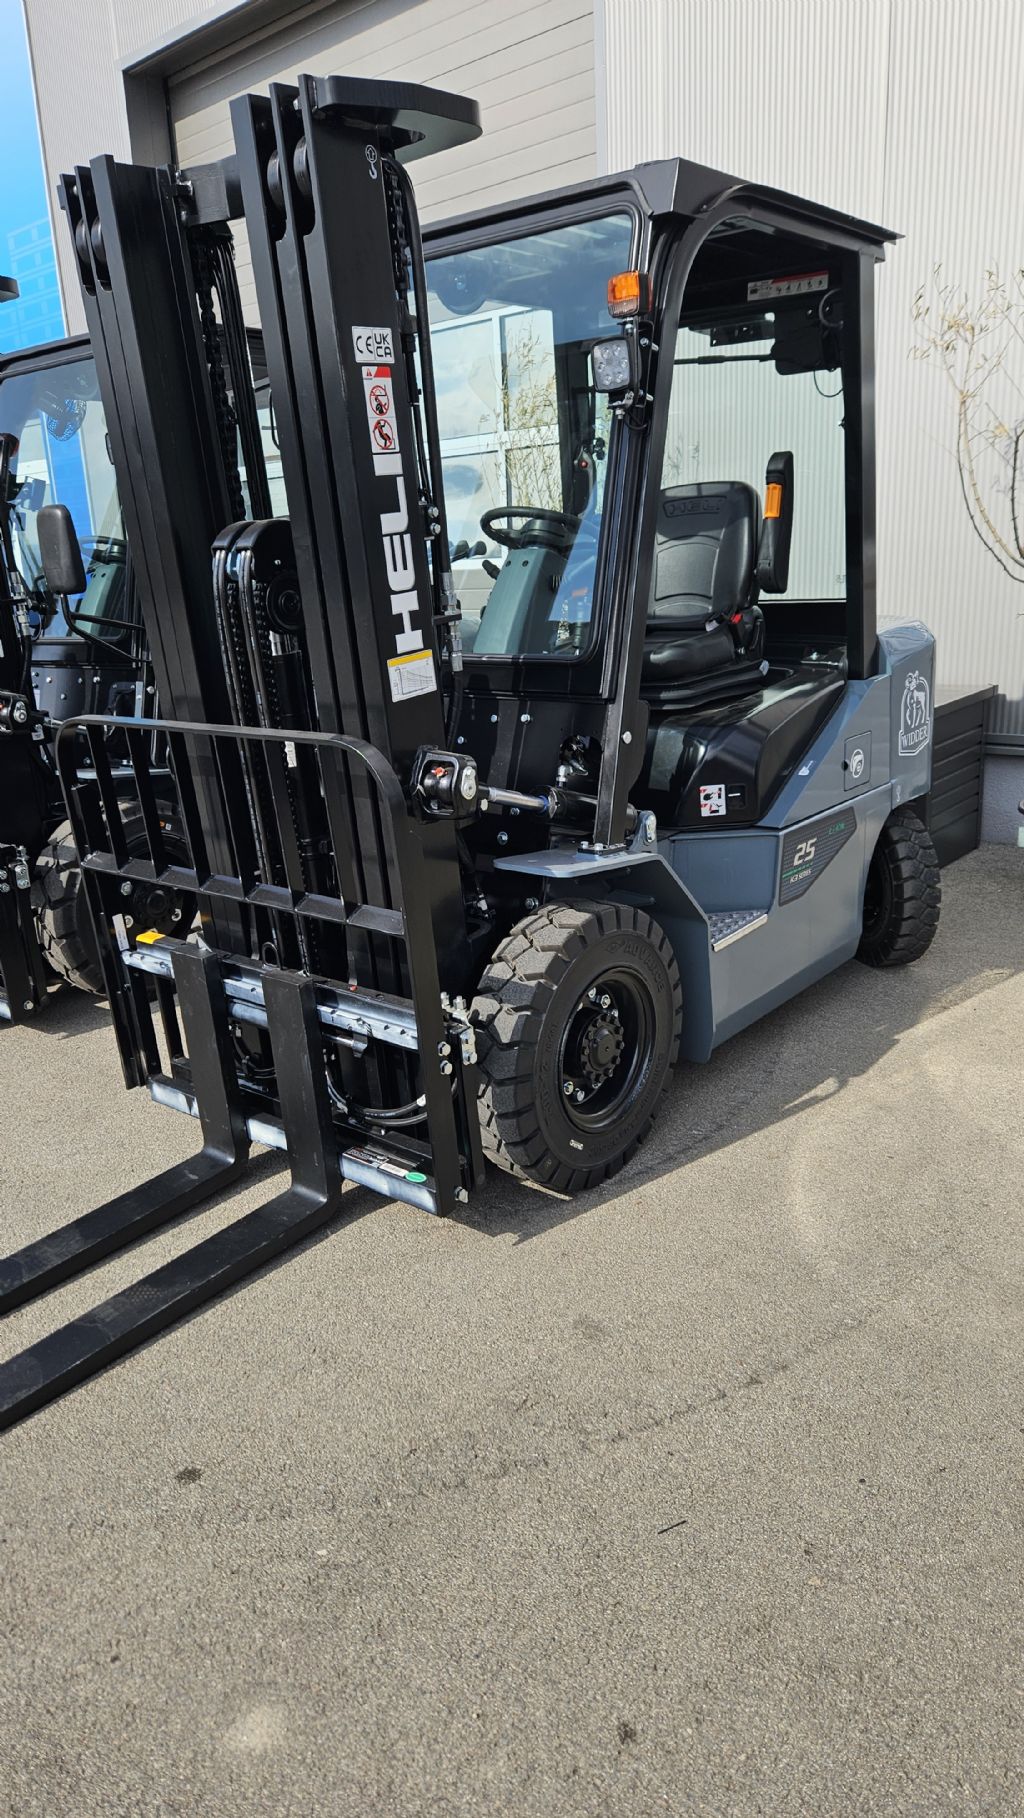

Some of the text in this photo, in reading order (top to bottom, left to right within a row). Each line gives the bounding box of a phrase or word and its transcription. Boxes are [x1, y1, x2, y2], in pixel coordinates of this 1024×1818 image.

[356, 335, 373, 354] CE
[374, 333, 391, 345] UK
[376, 346, 392, 357] CA
[373, 453, 424, 654] HELI
[902, 725, 928, 748] WIDDER
[793, 837, 817, 867] 25
